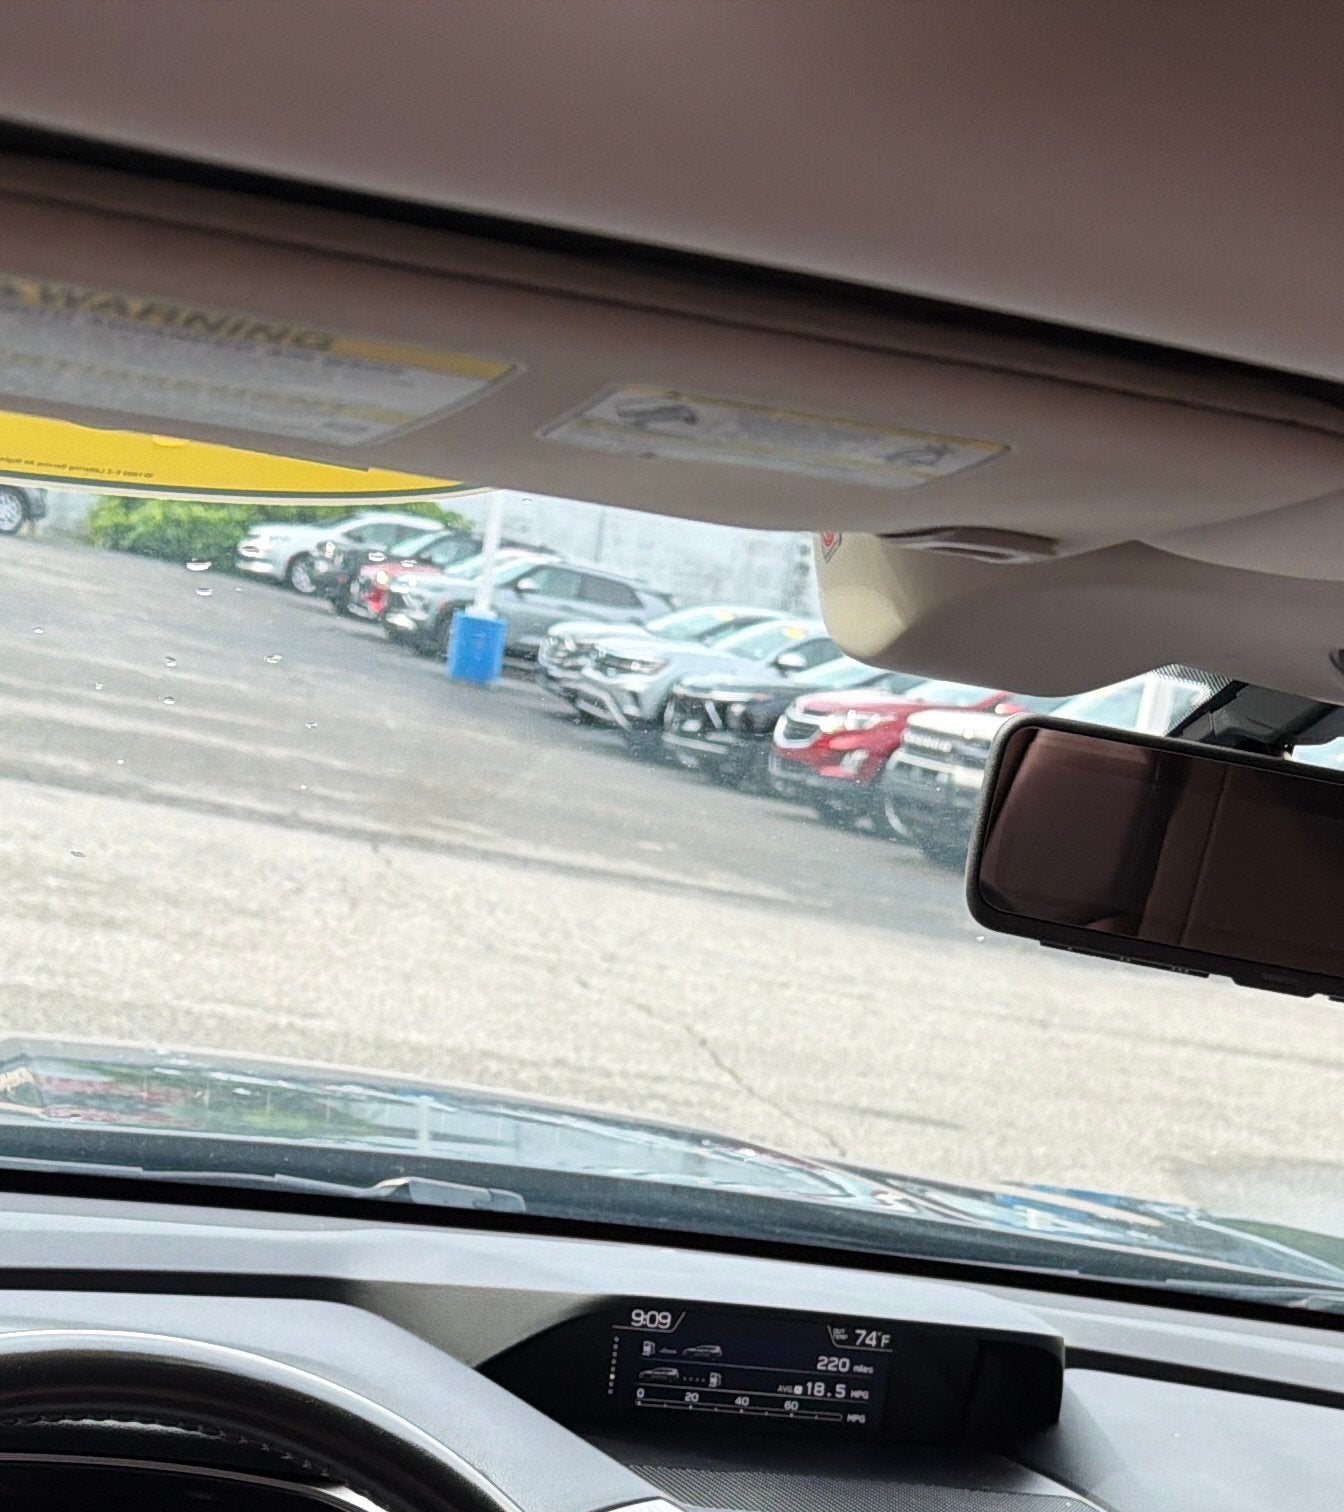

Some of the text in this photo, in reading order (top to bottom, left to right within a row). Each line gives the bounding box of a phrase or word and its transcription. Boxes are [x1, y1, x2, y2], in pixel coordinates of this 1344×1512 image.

[37, 283, 337, 352] WARNING
[631, 1309, 672, 1330] 9:09
[816, 1356, 850, 1373] 220
[806, 1381, 847, 1399] 18.5
[684, 1392, 699, 1403] 20
[734, 1396, 750, 1407] 40
[784, 1400, 799, 1411] 60
